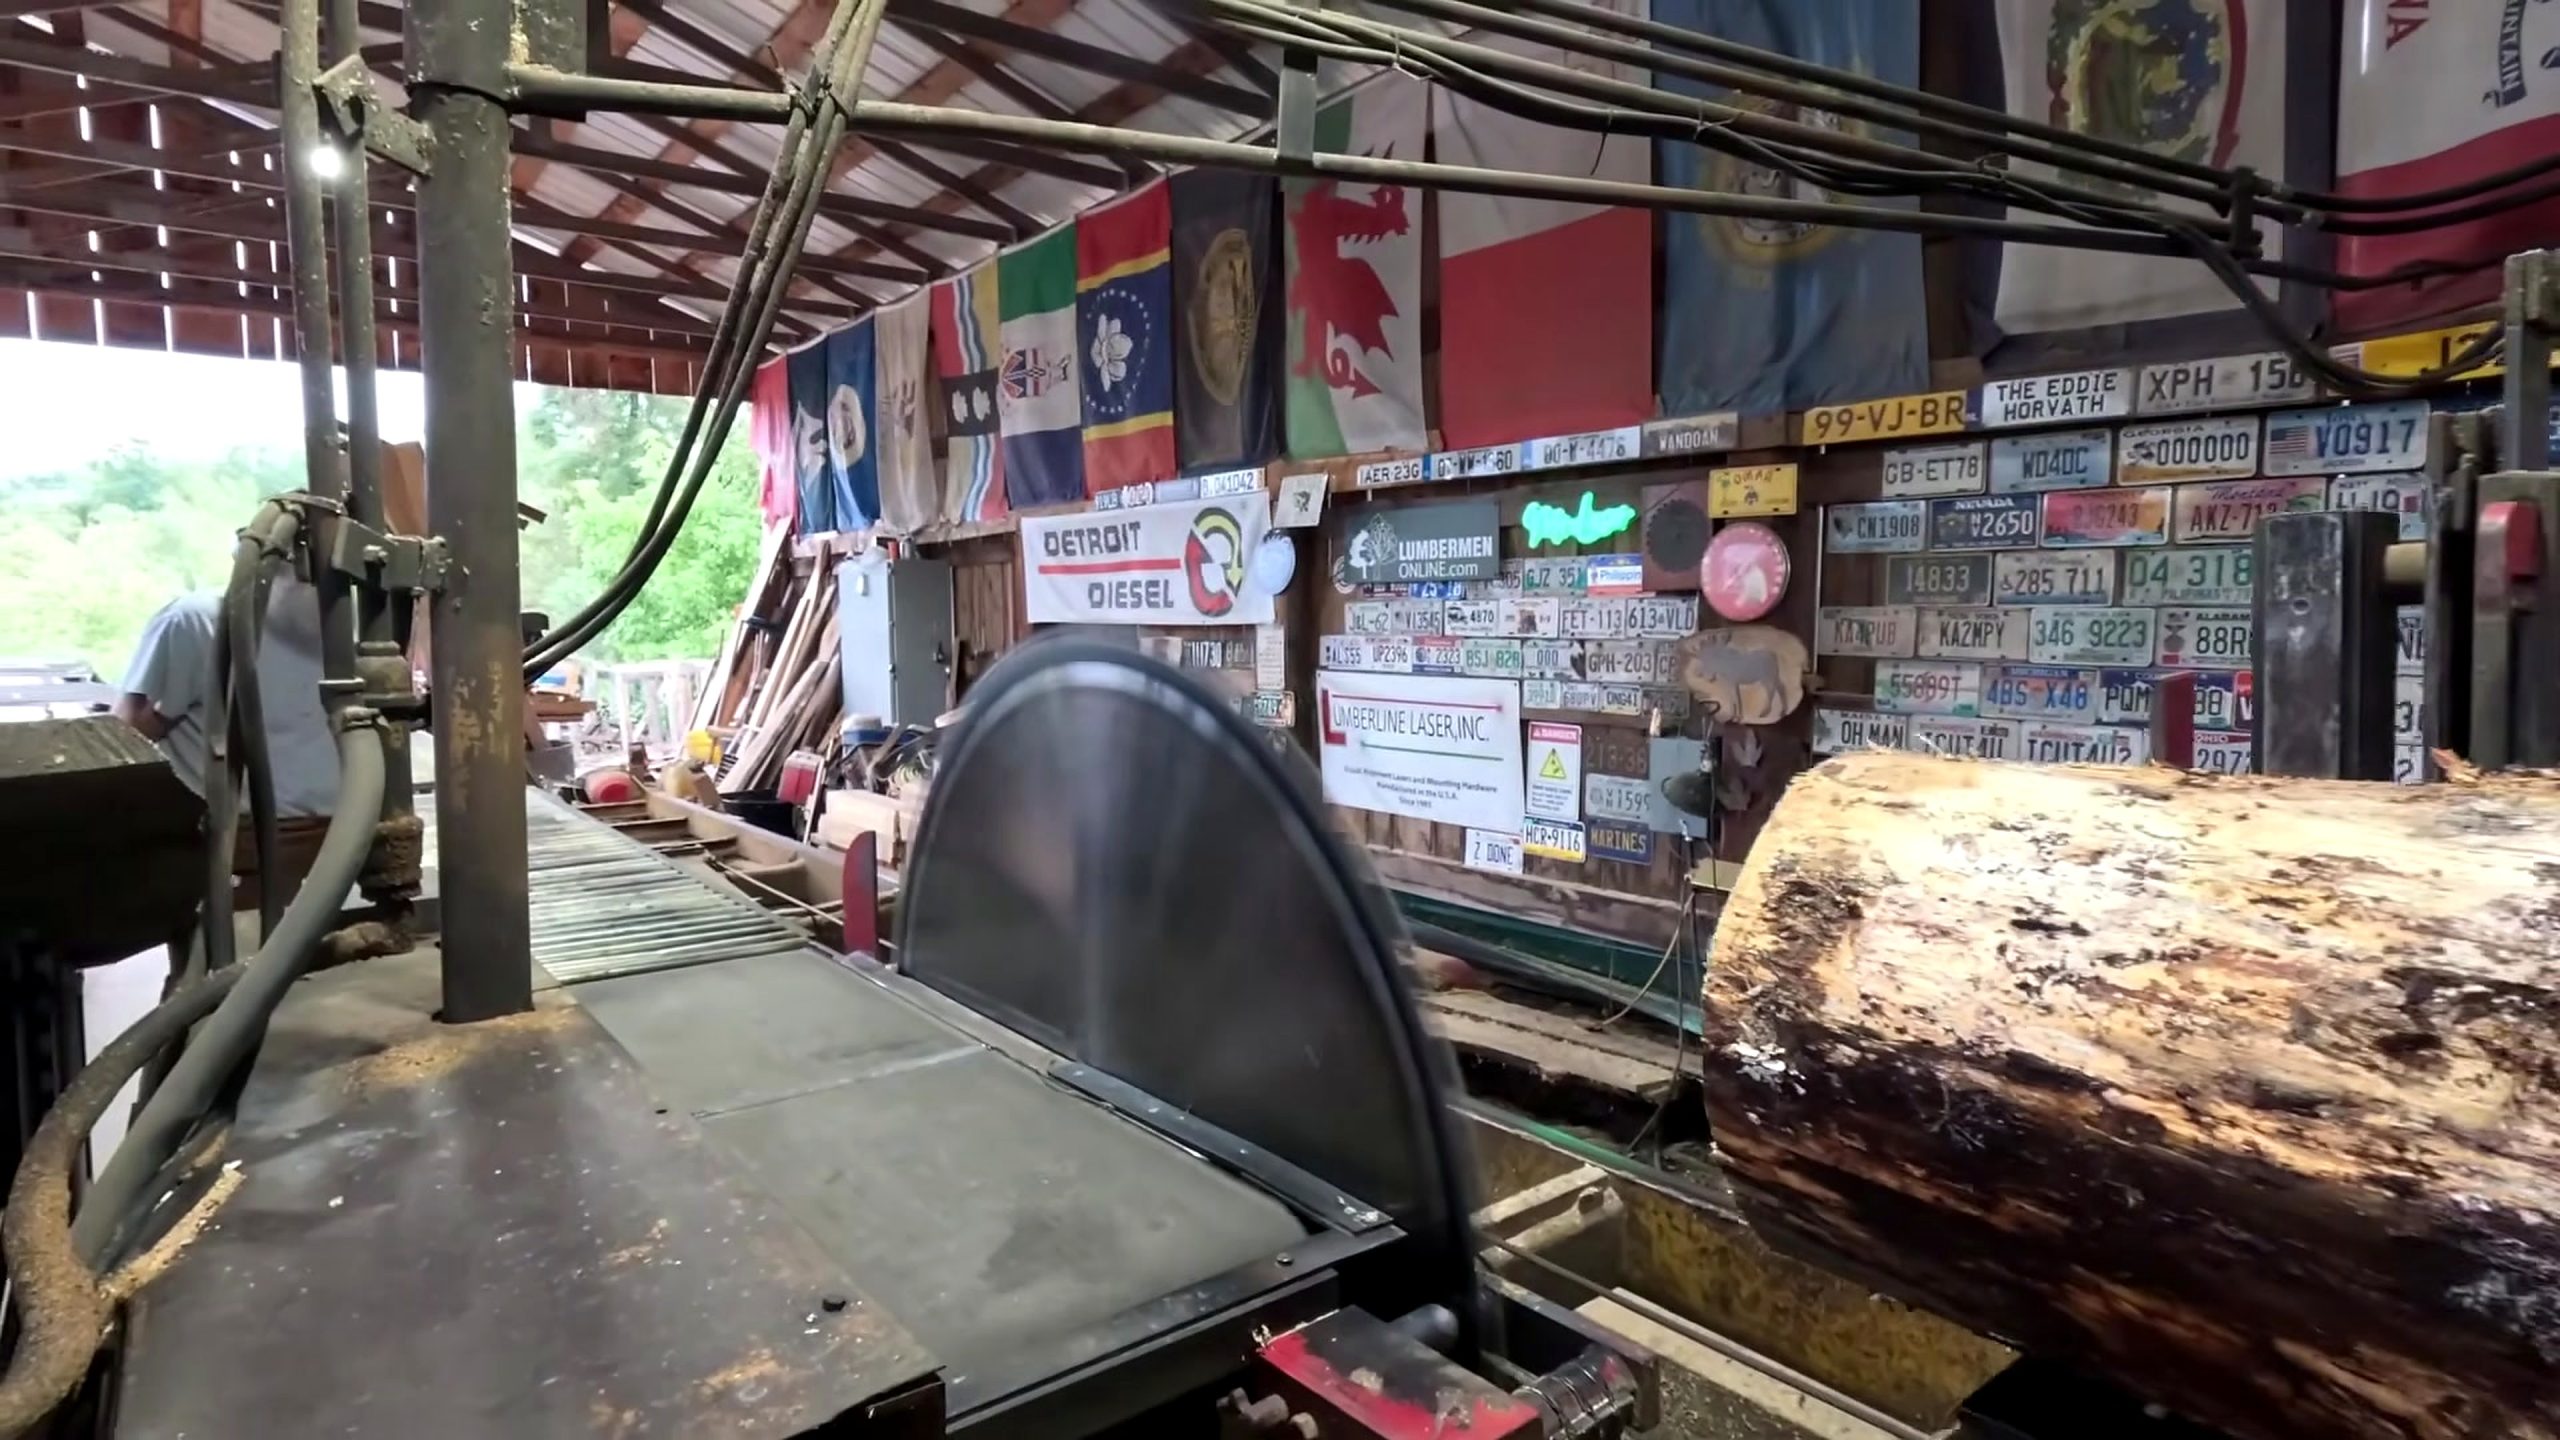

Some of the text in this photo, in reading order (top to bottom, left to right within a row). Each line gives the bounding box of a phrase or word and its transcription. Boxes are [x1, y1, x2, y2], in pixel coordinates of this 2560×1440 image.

[1997, 372, 2117, 401] THE EDDIE
[2148, 365, 2214, 402] XPH
[1815, 396, 1965, 439] 99-VJ-BR
[2004, 394, 2104, 422] HORVATH
[2123, 424, 2204, 439] GEORGIA
[2157, 430, 2249, 466] 000000
[1884, 455, 1979, 485] GB-ET78
[1955, 497, 2015, 510] NEVADA
[1044, 521, 1142, 558] DETROIT
[1399, 535, 1493, 562] LUMBERMEN
[1398, 561, 1479, 579] ONLINE.com
[2015, 567, 2104, 596] 285 711
[1088, 578, 1175, 610] DIESEL
[1628, 607, 1657, 631] 613
[2196, 612, 2250, 622] ALABAM
[2035, 618, 2147, 649] 346 9223
[2195, 625, 2251, 655] 88R
[1841, 720, 1863, 746] OH
[1590, 825, 1647, 854] MARINES
